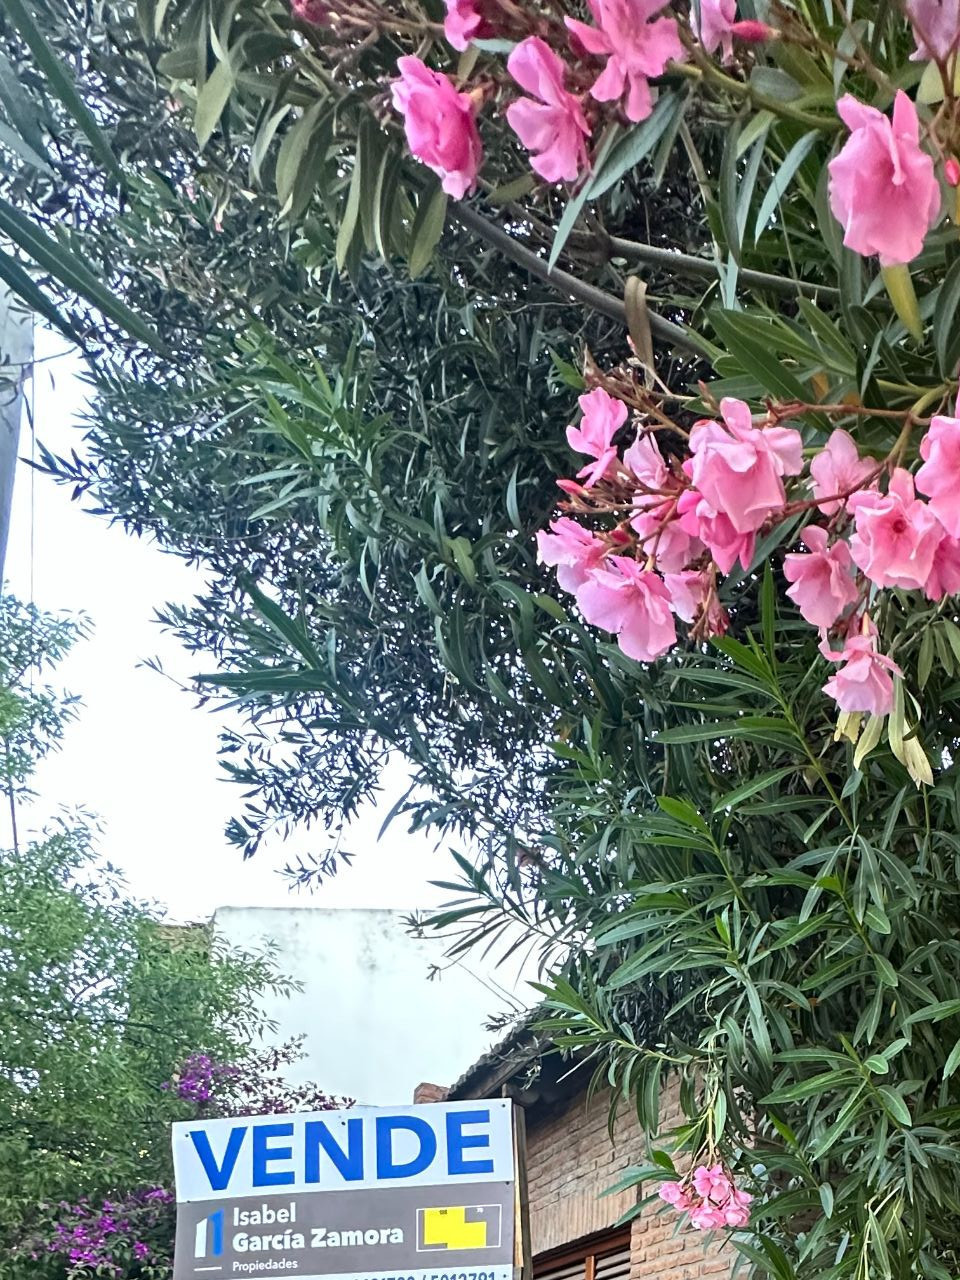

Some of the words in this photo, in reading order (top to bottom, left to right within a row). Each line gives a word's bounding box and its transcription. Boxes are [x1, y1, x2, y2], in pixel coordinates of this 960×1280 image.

[189, 1109, 495, 1191] VENDE
[233, 1202, 296, 1226] Isabel
[232, 1229, 305, 1252] García
[310, 1227, 404, 1248] Zamora
[232, 1258, 298, 1273] Propiedades
